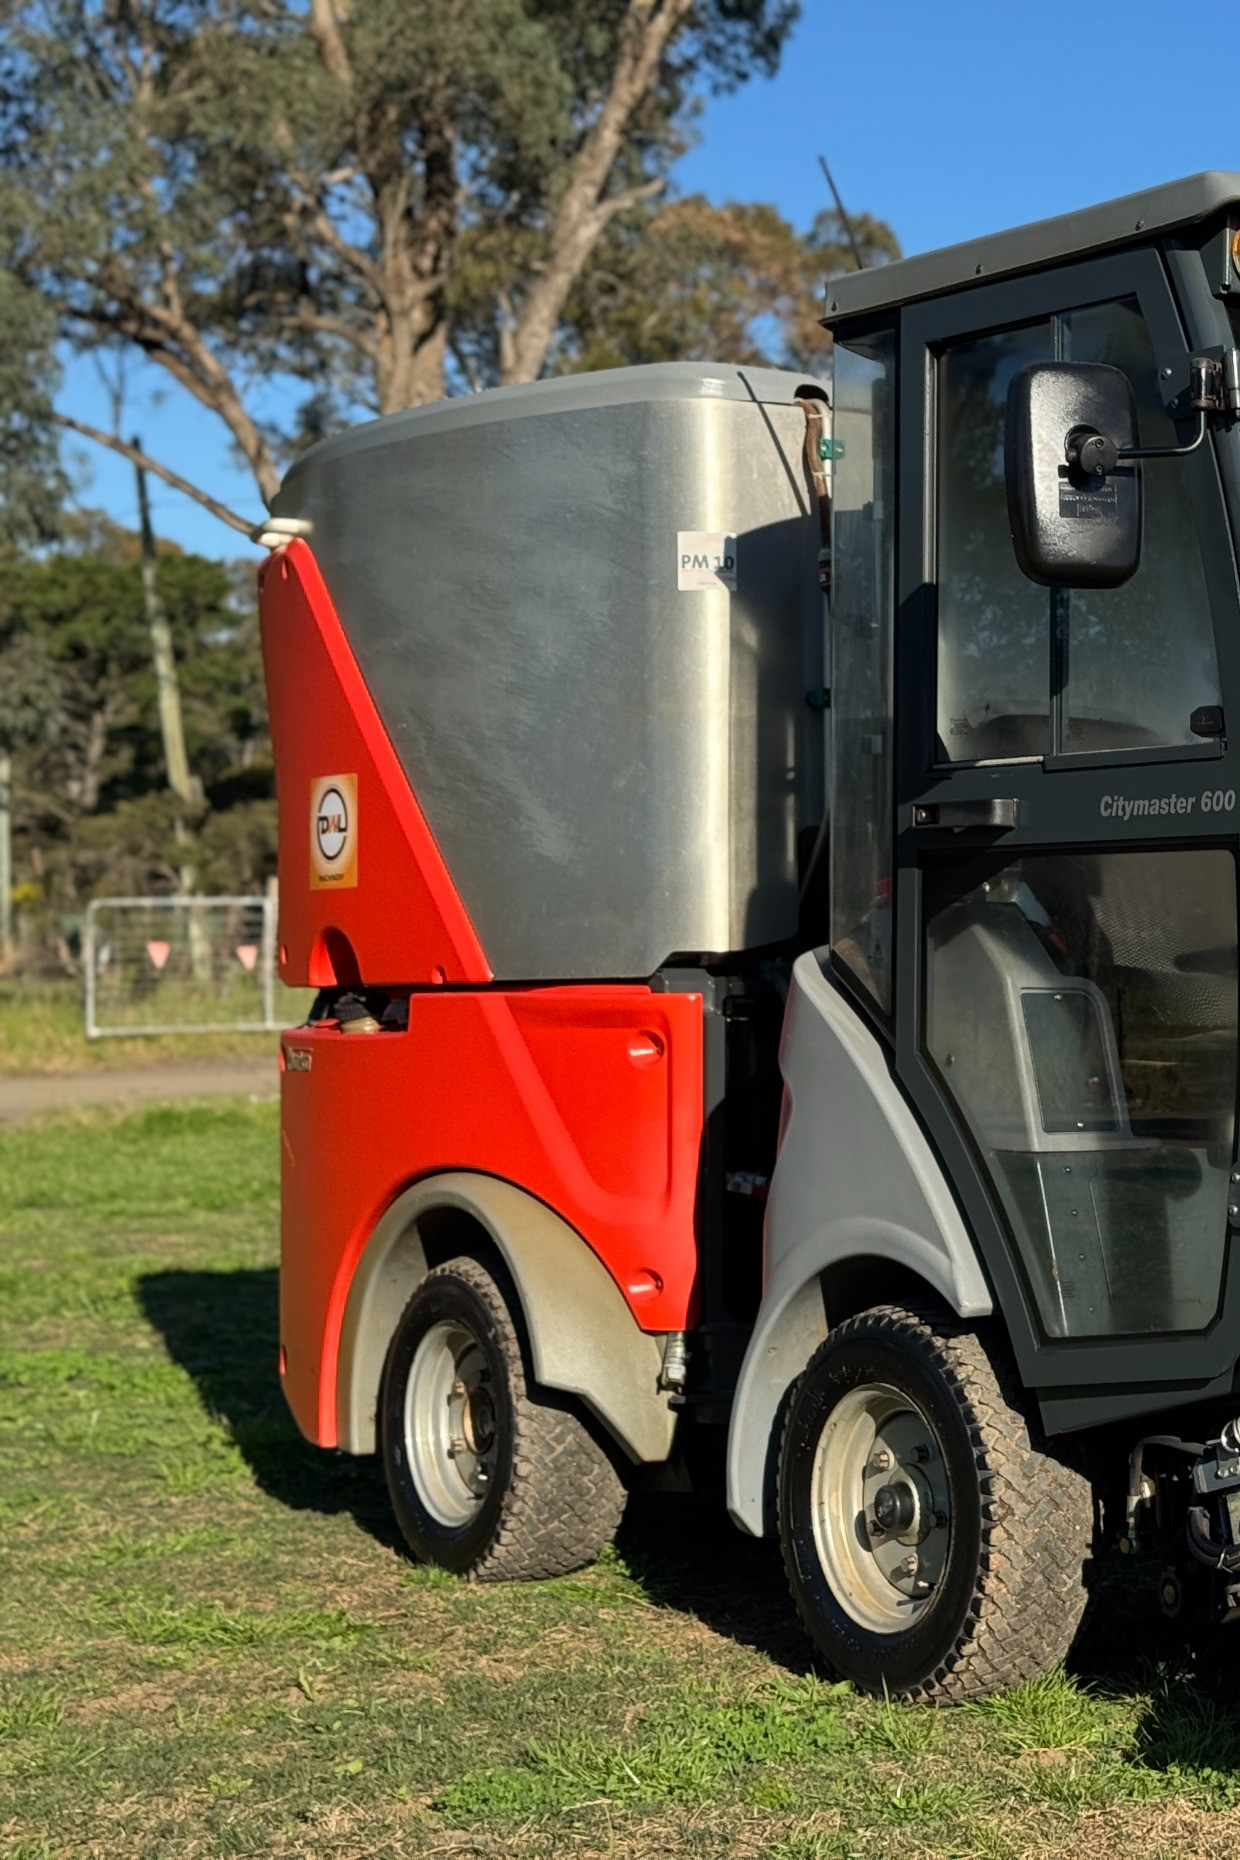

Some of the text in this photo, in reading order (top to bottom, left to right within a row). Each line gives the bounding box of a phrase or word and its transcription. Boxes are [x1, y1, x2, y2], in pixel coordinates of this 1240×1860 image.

[681, 554, 735, 570] PM 10
[1100, 789, 1236, 821] Citymaster 600
